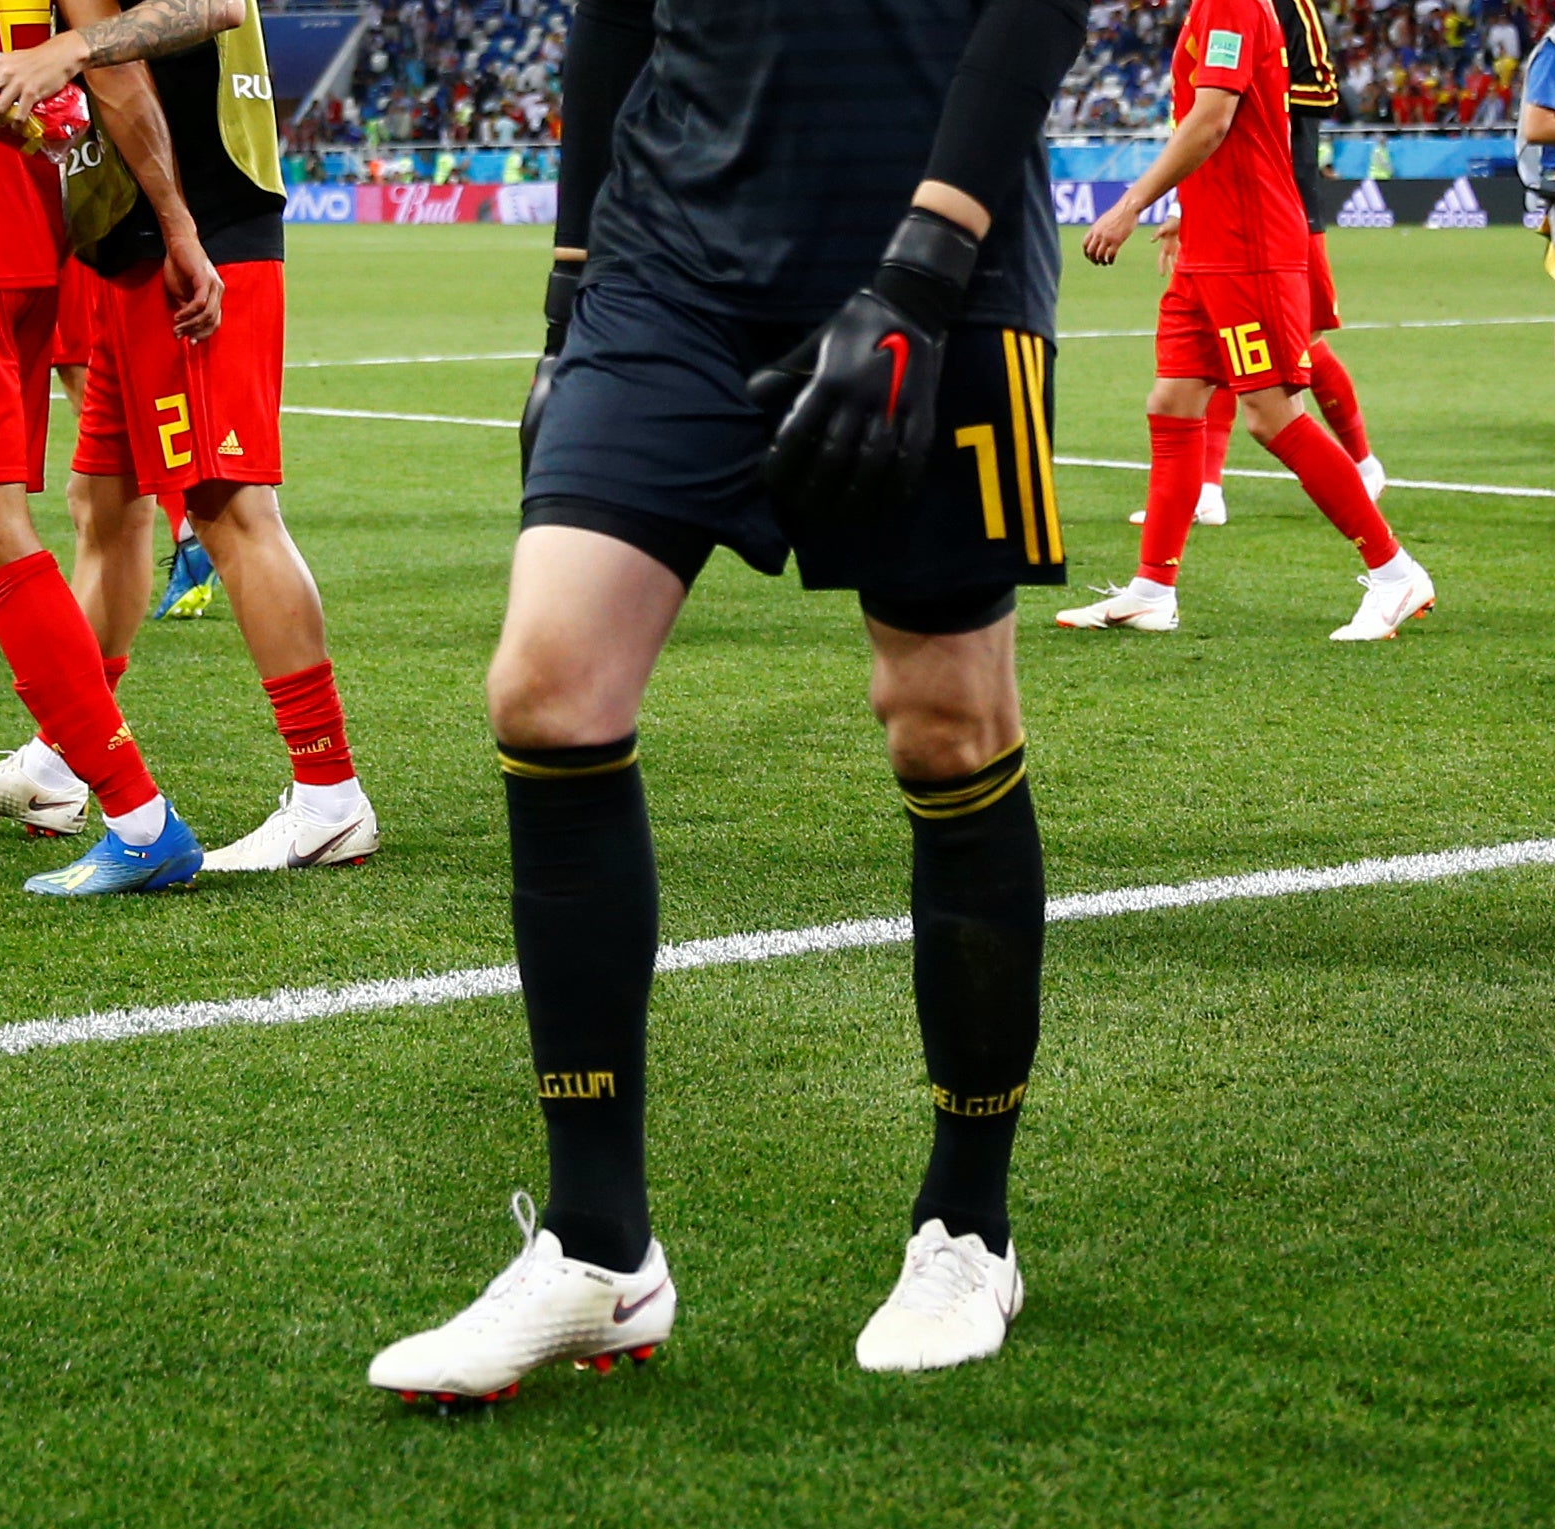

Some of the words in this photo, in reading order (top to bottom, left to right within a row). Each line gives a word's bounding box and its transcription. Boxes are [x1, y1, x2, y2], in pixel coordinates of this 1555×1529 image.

[388, 182, 464, 224] Bud
[1336, 210, 1395, 227] adidas
[1428, 210, 1488, 228] adidas
[1219, 321, 1272, 377] 16
[155, 393, 192, 469] 2
[954, 424, 1007, 539] 1
